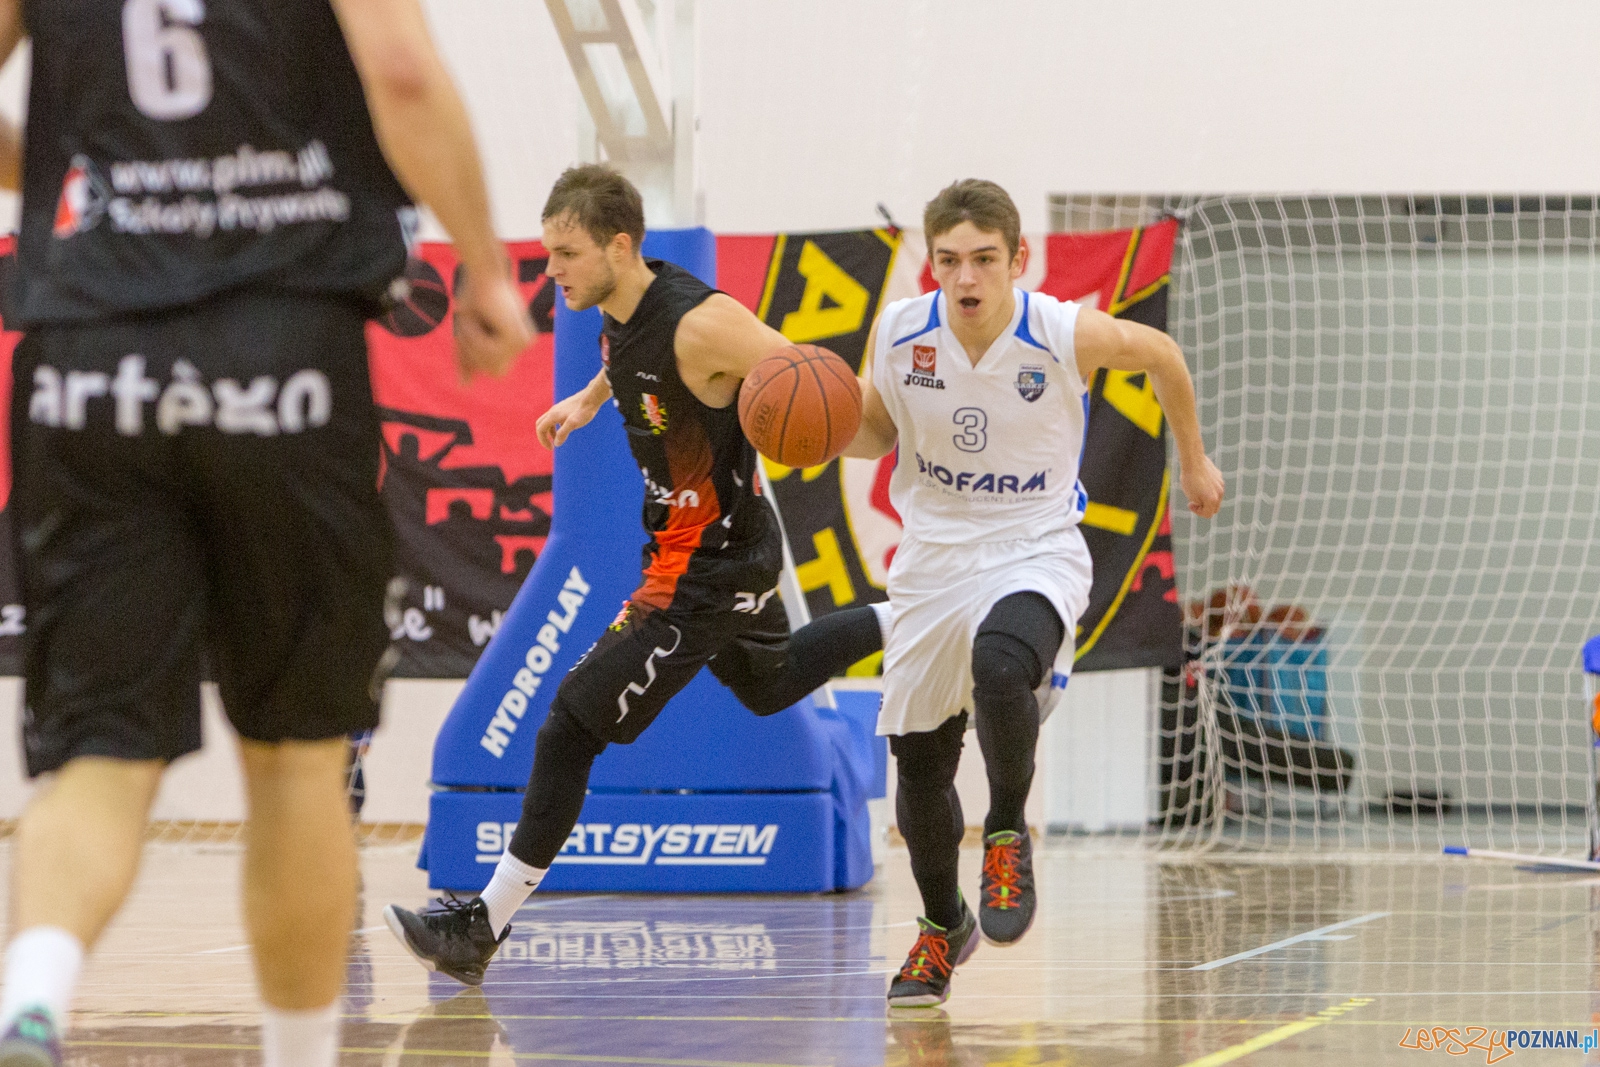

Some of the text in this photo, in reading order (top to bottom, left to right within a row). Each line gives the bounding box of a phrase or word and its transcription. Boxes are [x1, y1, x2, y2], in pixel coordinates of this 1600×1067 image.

[122, 0, 213, 120] 6
[953, 407, 987, 453] 3
[480, 565, 592, 759] HYDROPLAY
